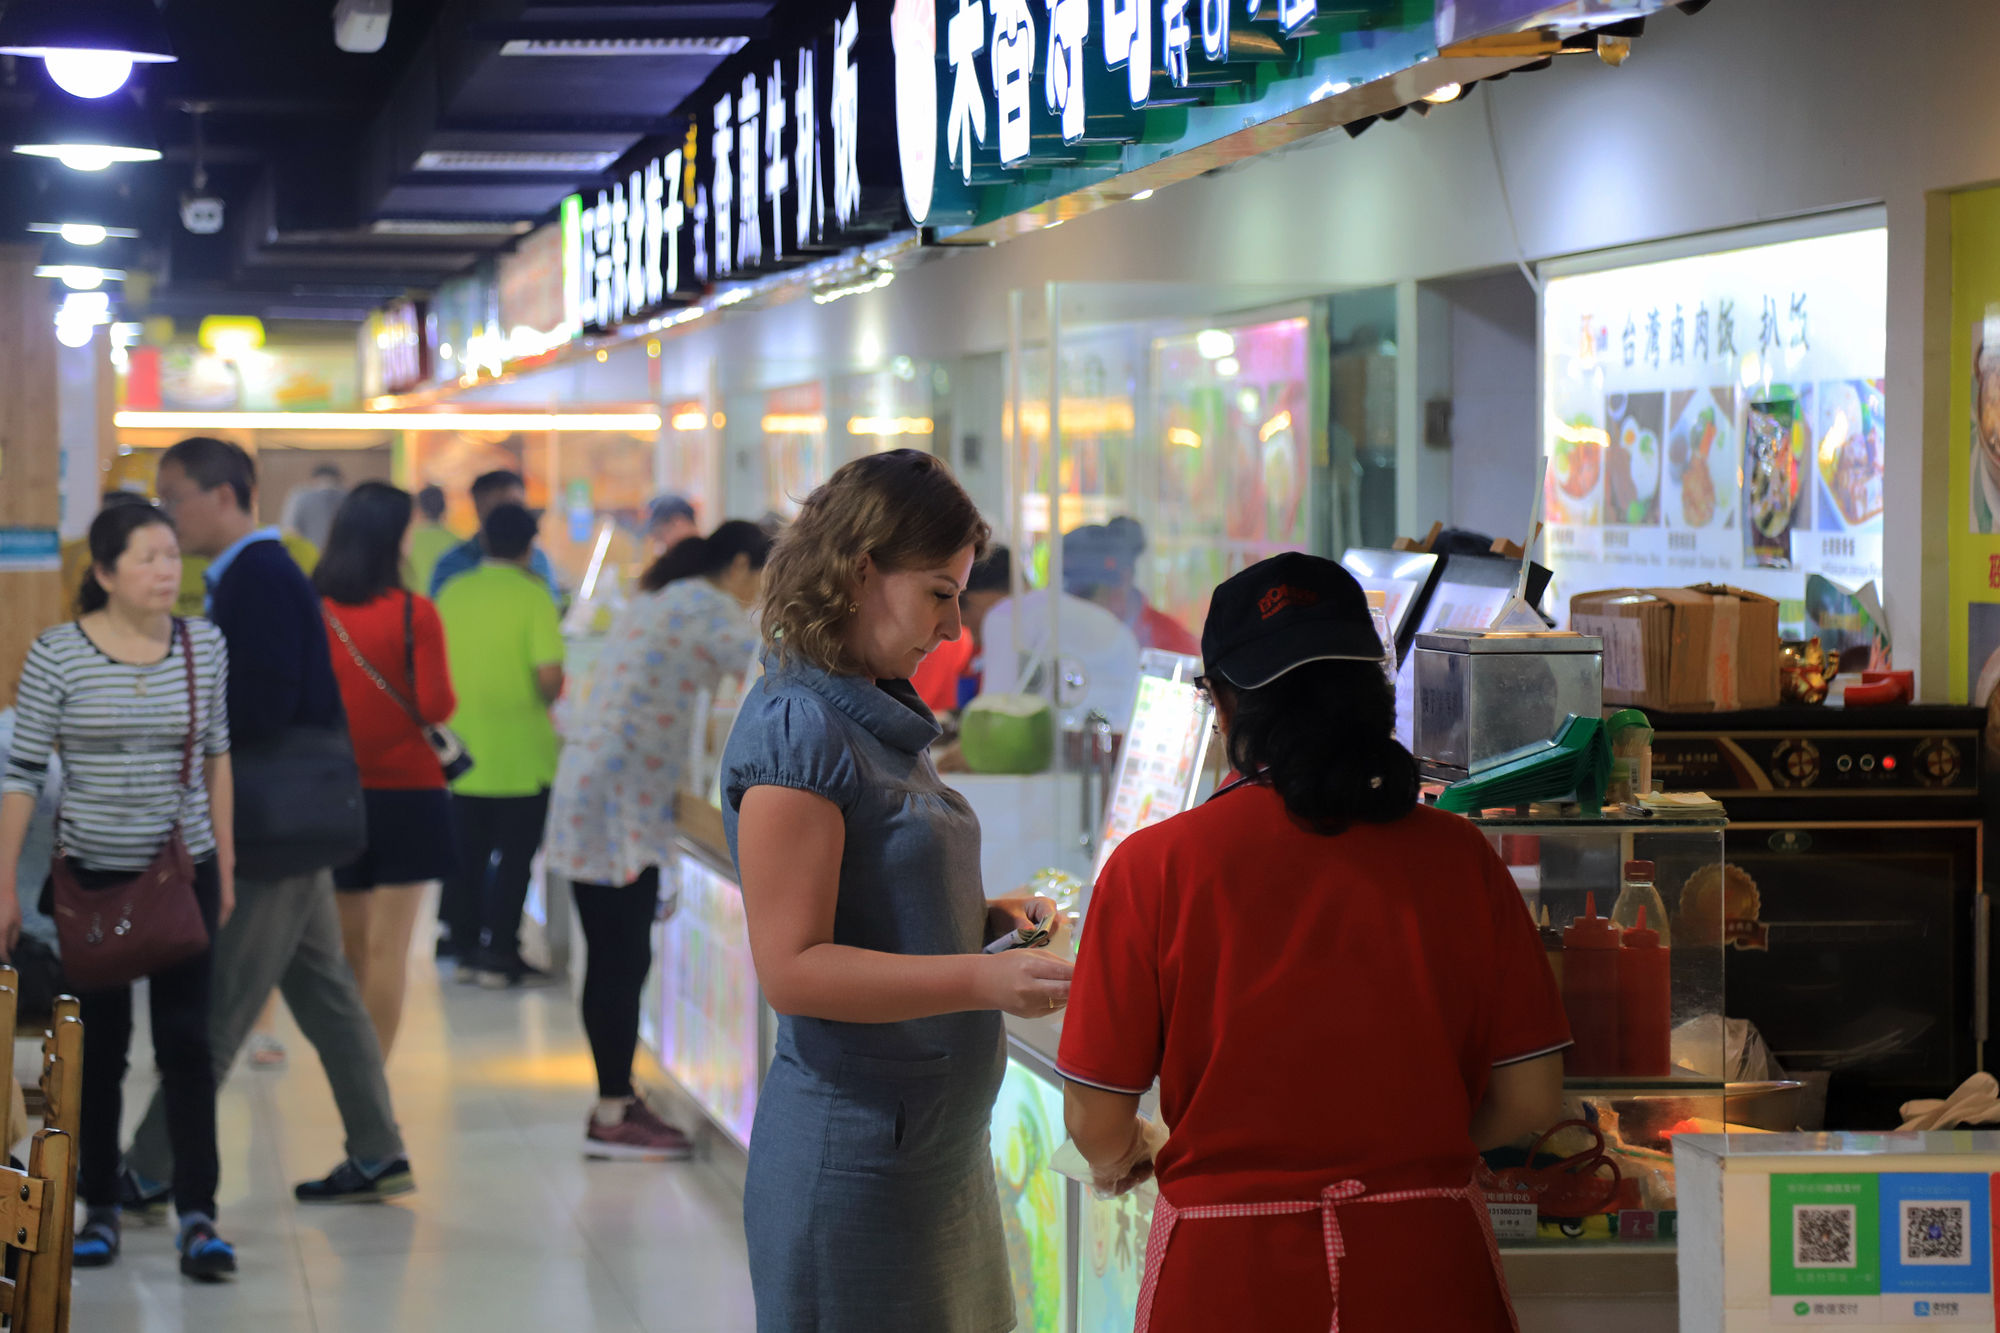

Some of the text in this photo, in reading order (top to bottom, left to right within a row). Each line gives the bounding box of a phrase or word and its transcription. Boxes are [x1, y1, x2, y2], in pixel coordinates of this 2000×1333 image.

[1622, 298, 1738, 370] 台湾卤肉饭
[1814, 1302, 1858, 1315] 微信支付
